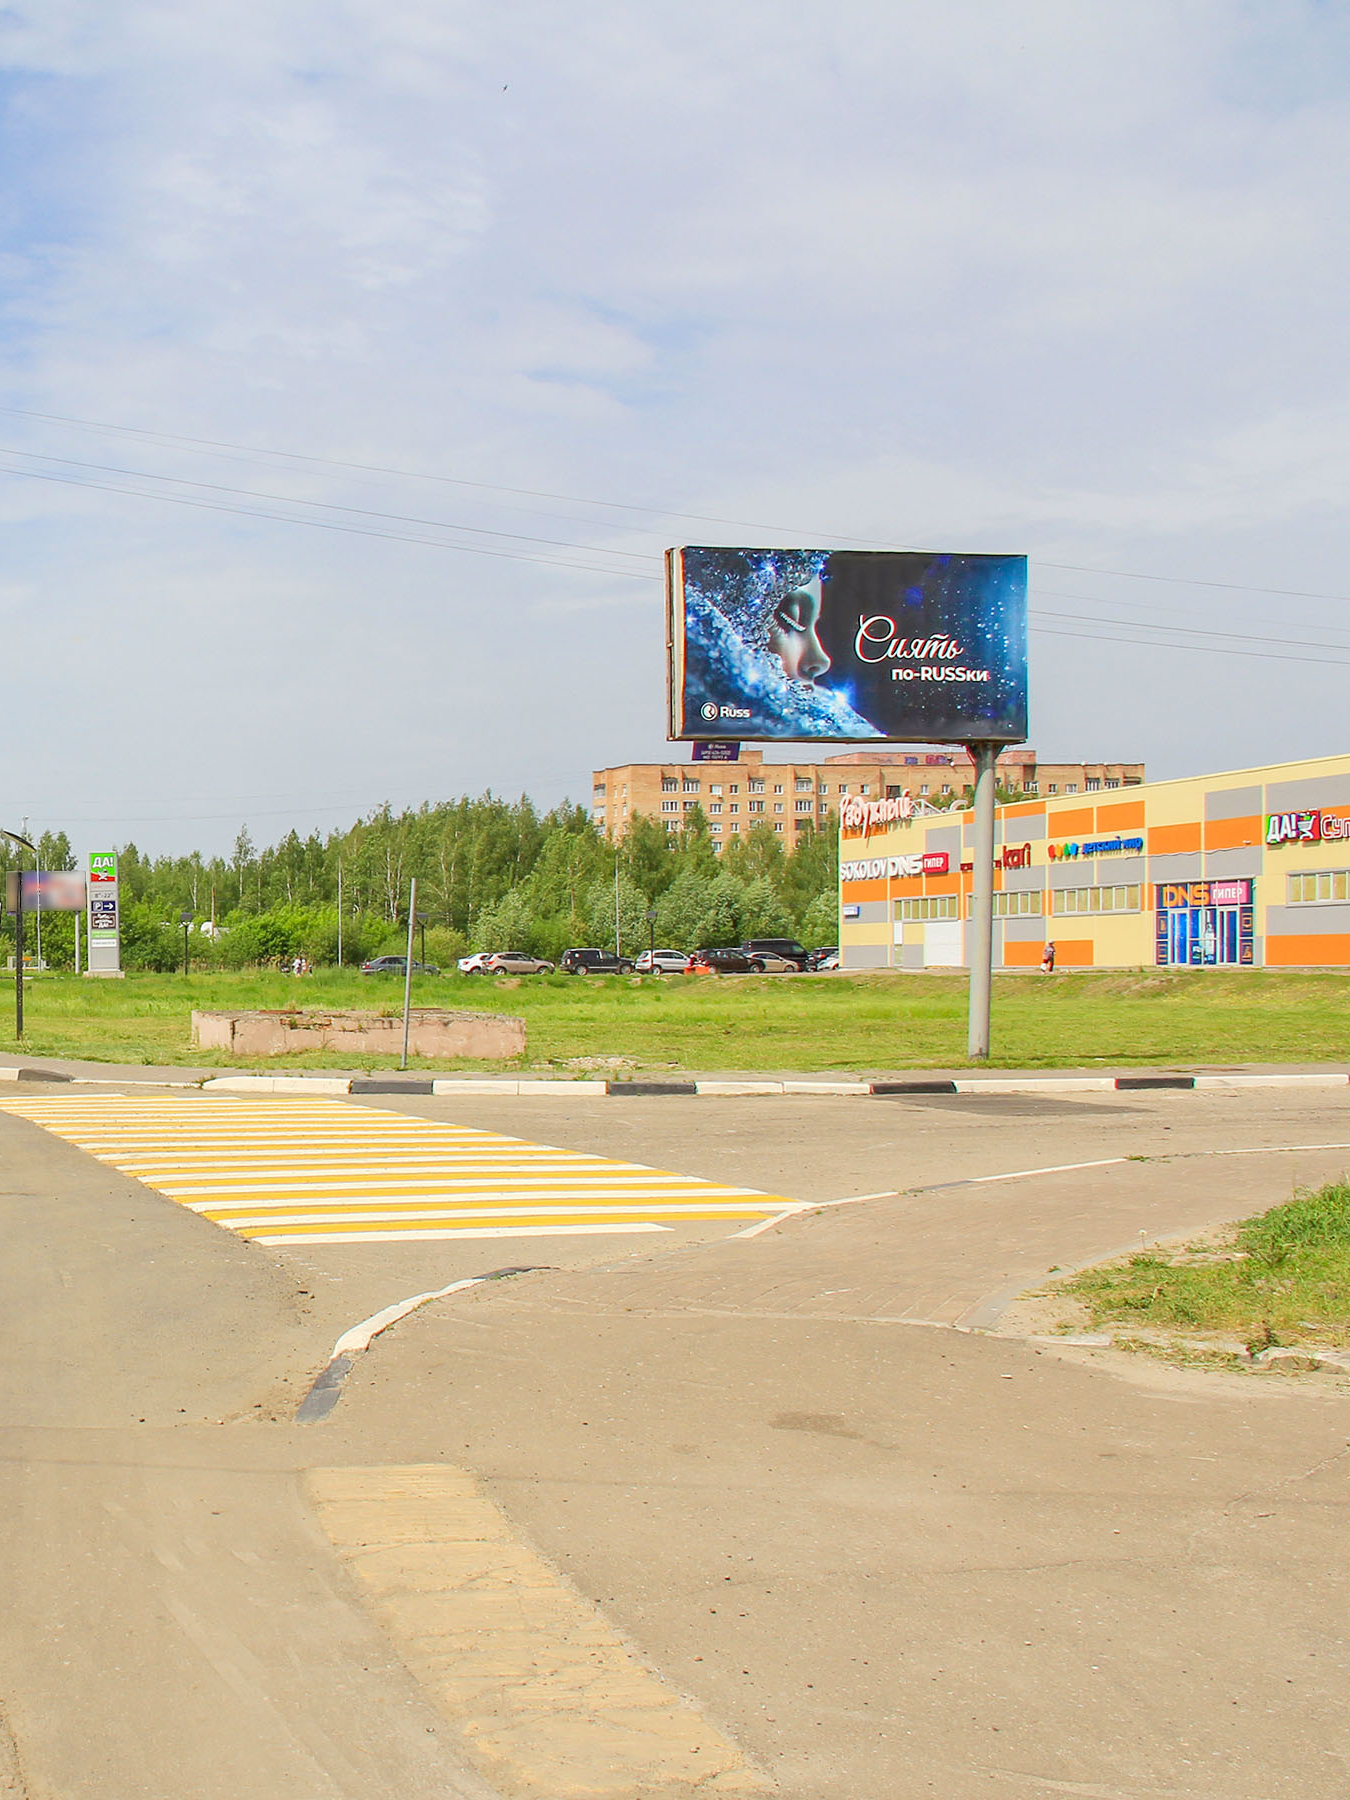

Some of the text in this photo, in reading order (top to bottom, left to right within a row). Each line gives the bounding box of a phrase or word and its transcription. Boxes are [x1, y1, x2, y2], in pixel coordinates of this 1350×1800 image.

[855, 614, 963, 663] Сиять
[891, 666, 989, 682] по-RUSSки
[719, 706, 750, 718] Russ
[1266, 813, 1297, 843] ДА!
[92, 856, 114, 868] ДА!
[888, 854, 923, 877] DNS
[923, 857, 944, 869] ГИПЕР
[1003, 843, 1031, 869] kari
[840, 859, 887, 881] SOKOLOV
[1162, 884, 1243, 907] DNS ГИПЕР
